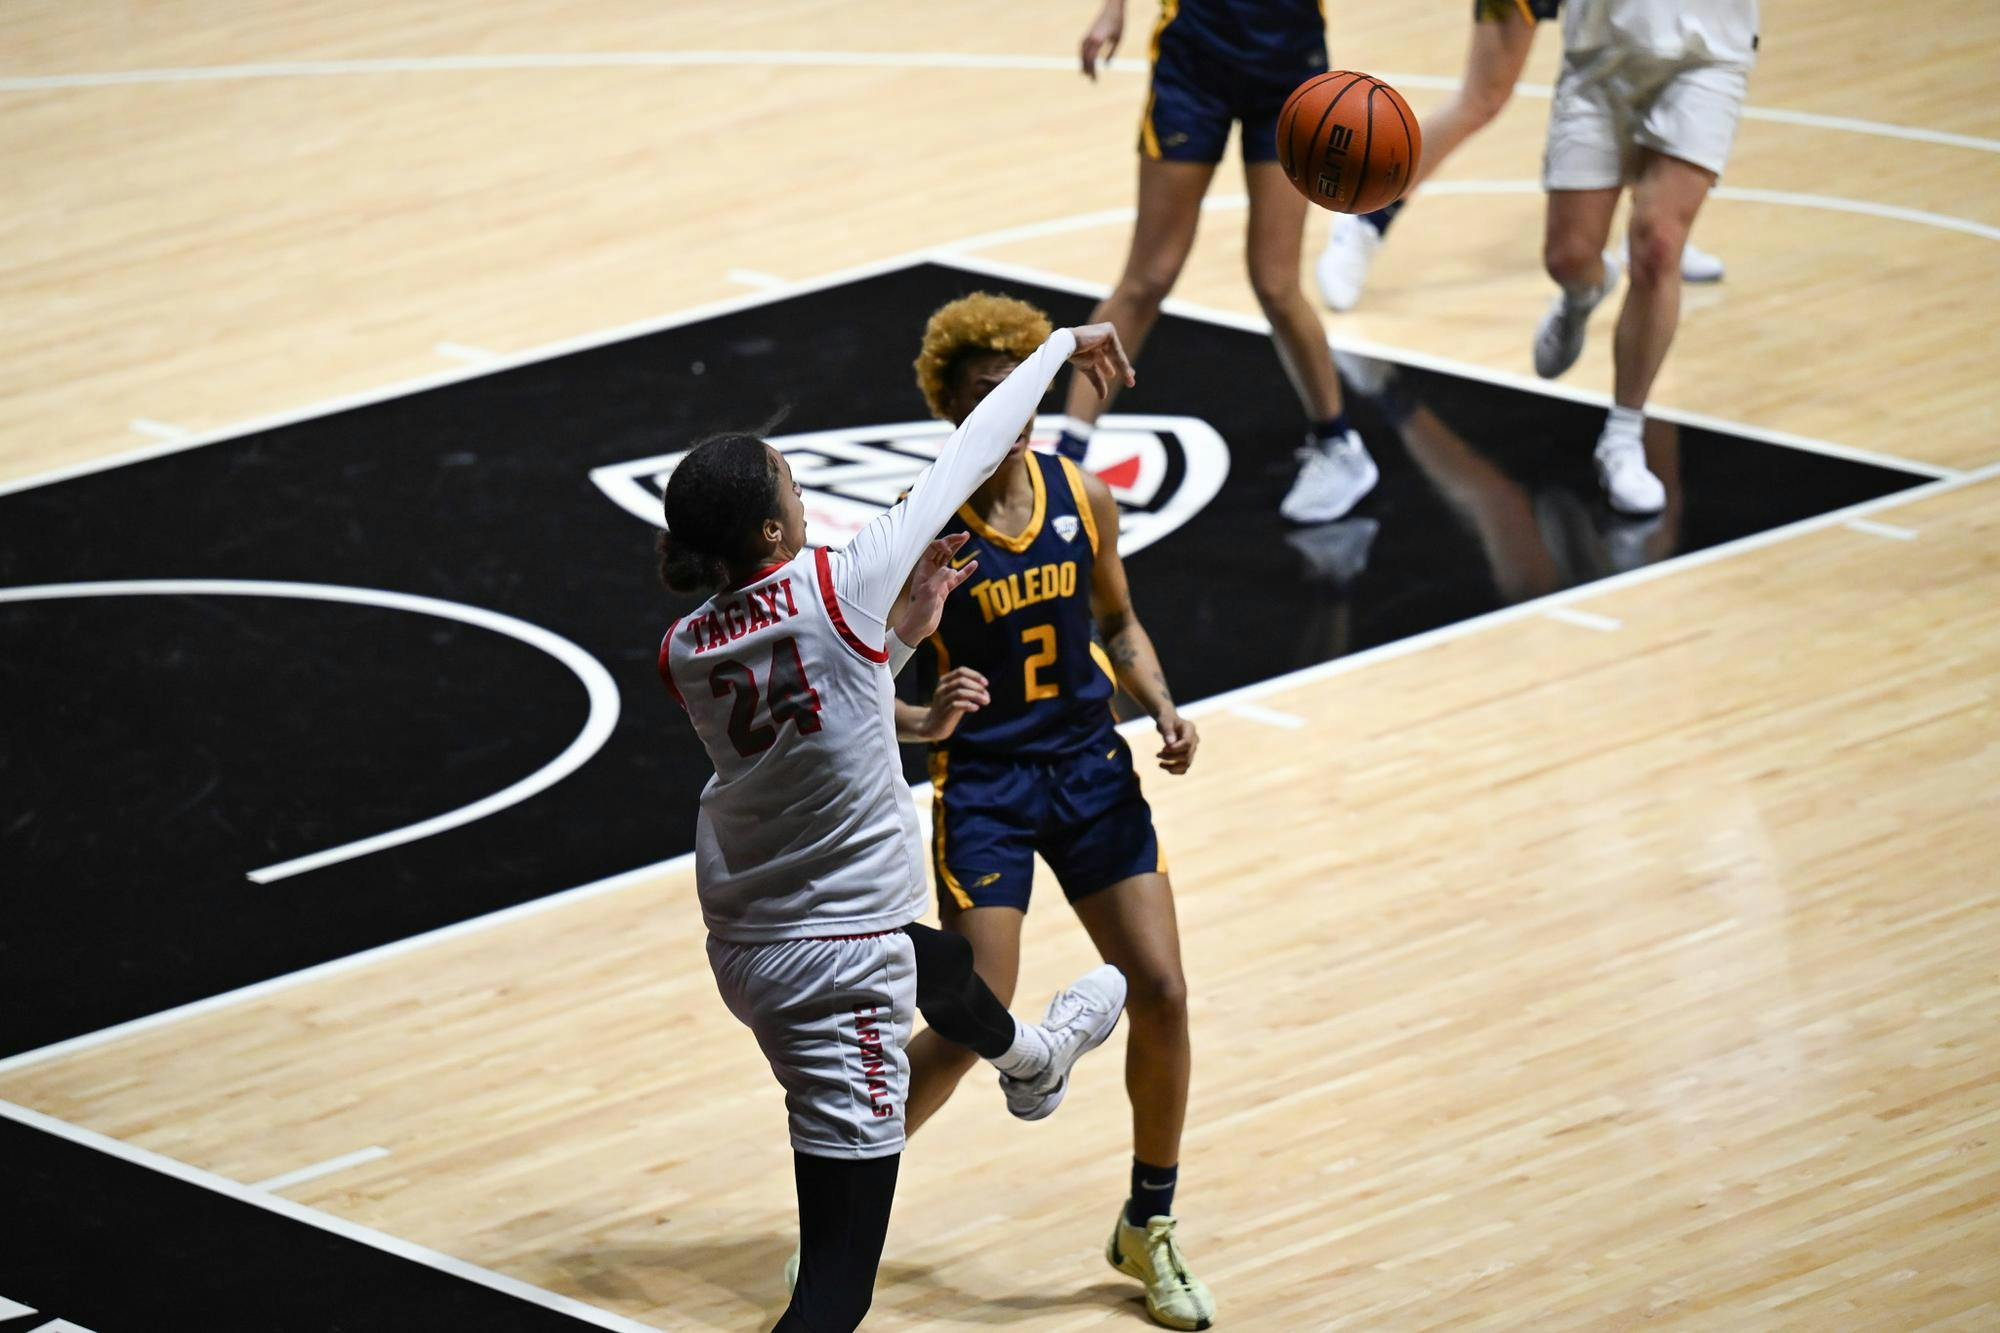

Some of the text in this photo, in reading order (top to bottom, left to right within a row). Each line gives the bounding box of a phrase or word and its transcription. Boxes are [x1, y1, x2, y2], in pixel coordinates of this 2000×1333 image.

[687, 578, 798, 654] TAGAYI
[970, 561, 1077, 624] TOLEDO
[709, 637, 822, 757] 24
[1022, 624, 1060, 702] 2
